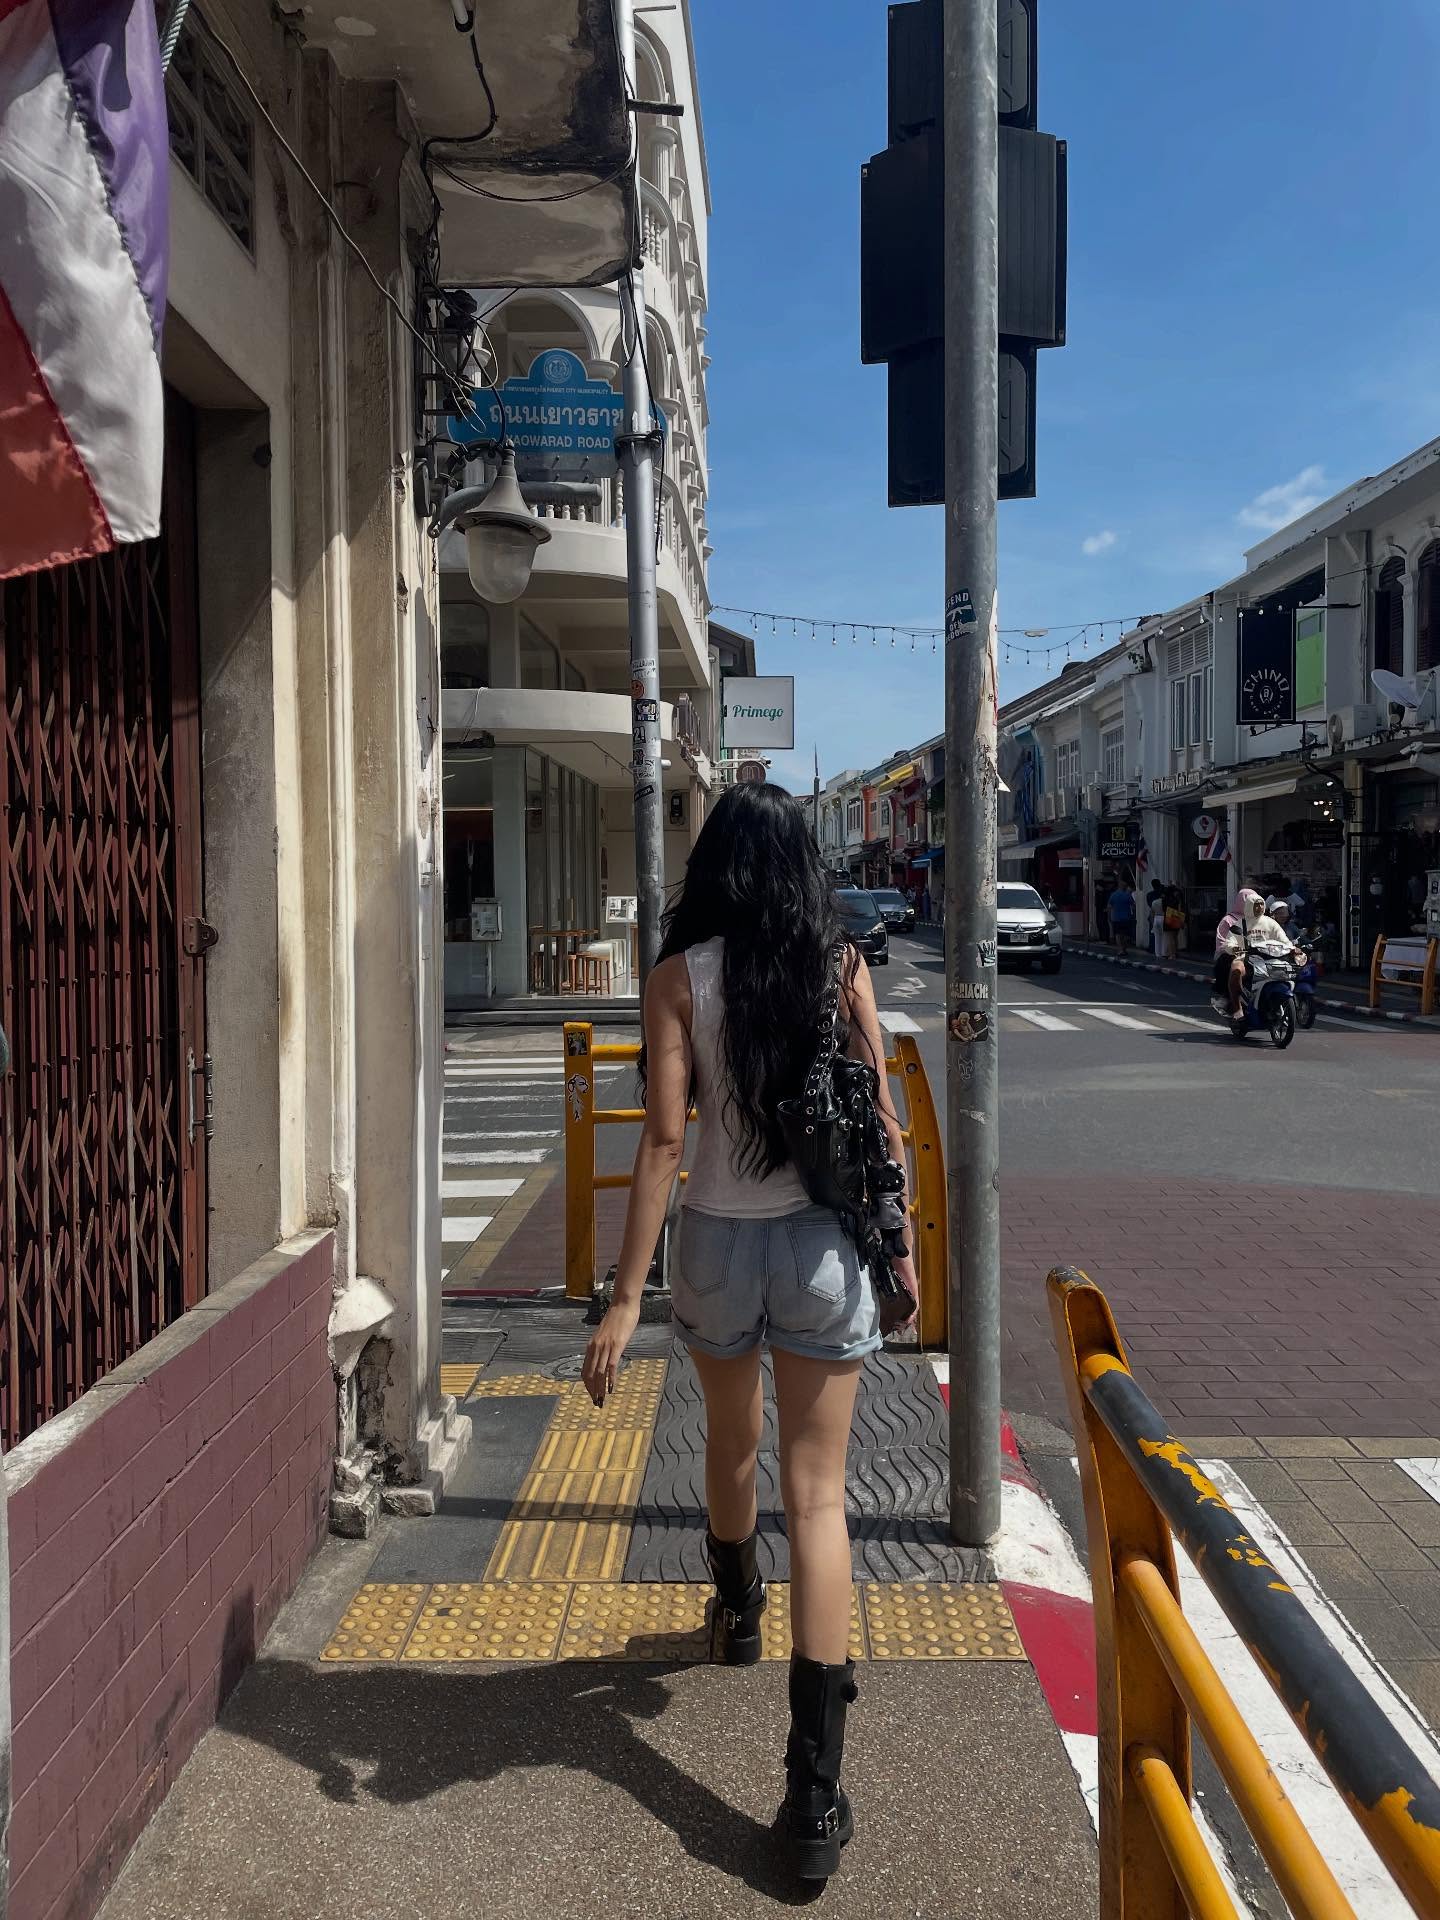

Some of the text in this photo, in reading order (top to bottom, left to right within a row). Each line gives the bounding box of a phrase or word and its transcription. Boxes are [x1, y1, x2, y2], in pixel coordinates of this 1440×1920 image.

[577, 436, 610, 449] ROAD
[732, 704, 784, 721] Primego
[1101, 847, 1136, 856] KOKU
